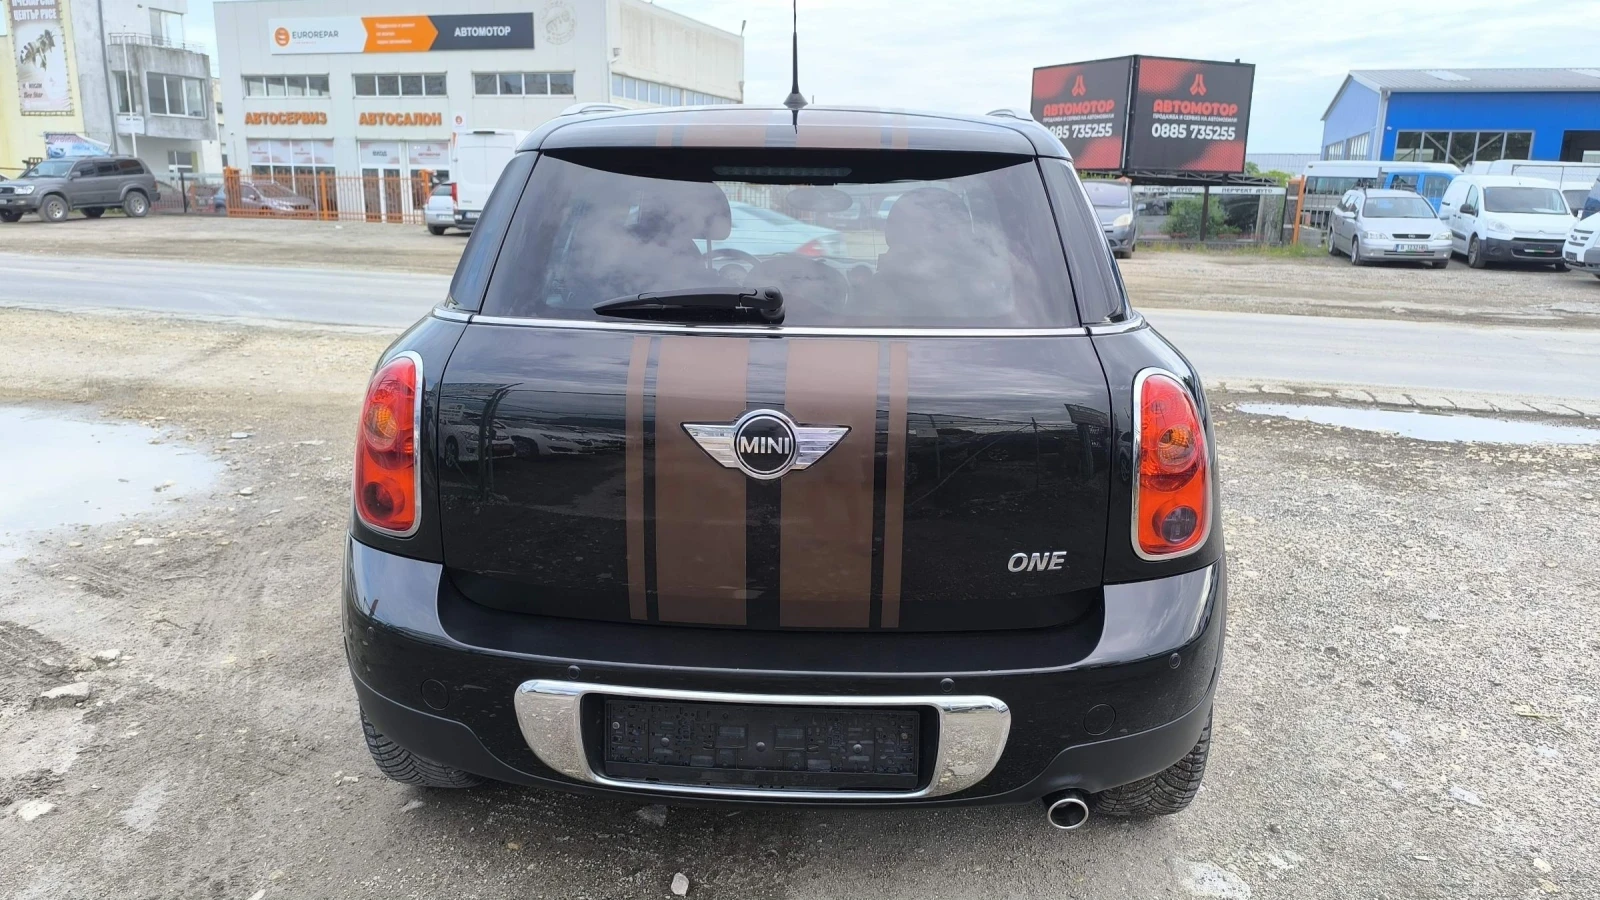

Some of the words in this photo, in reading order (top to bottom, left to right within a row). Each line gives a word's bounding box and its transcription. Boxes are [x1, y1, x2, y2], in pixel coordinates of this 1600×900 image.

[13, 9, 39, 21] ЦЕНТЪР
[40, 8, 57, 20] РУСЕ
[292, 30, 339, 39] EUROREPAR
[454, 26, 511, 37] АВТОМОТОР
[1043, 99, 1115, 116] АВТОМОТОР
[1153, 99, 1238, 116] АВТОМОТОР
[245, 111, 327, 125] АВТОСЕРВИЗ
[359, 112, 442, 126] АВТОСАЛОН
[1046, 124, 1070, 139] 885
[1072, 123, 1113, 138] 735255
[1151, 123, 1187, 138] 0885
[1190, 124, 1236, 140] 735255
[740, 436, 790, 454] MINI
[1007, 551, 1067, 572] ONE
